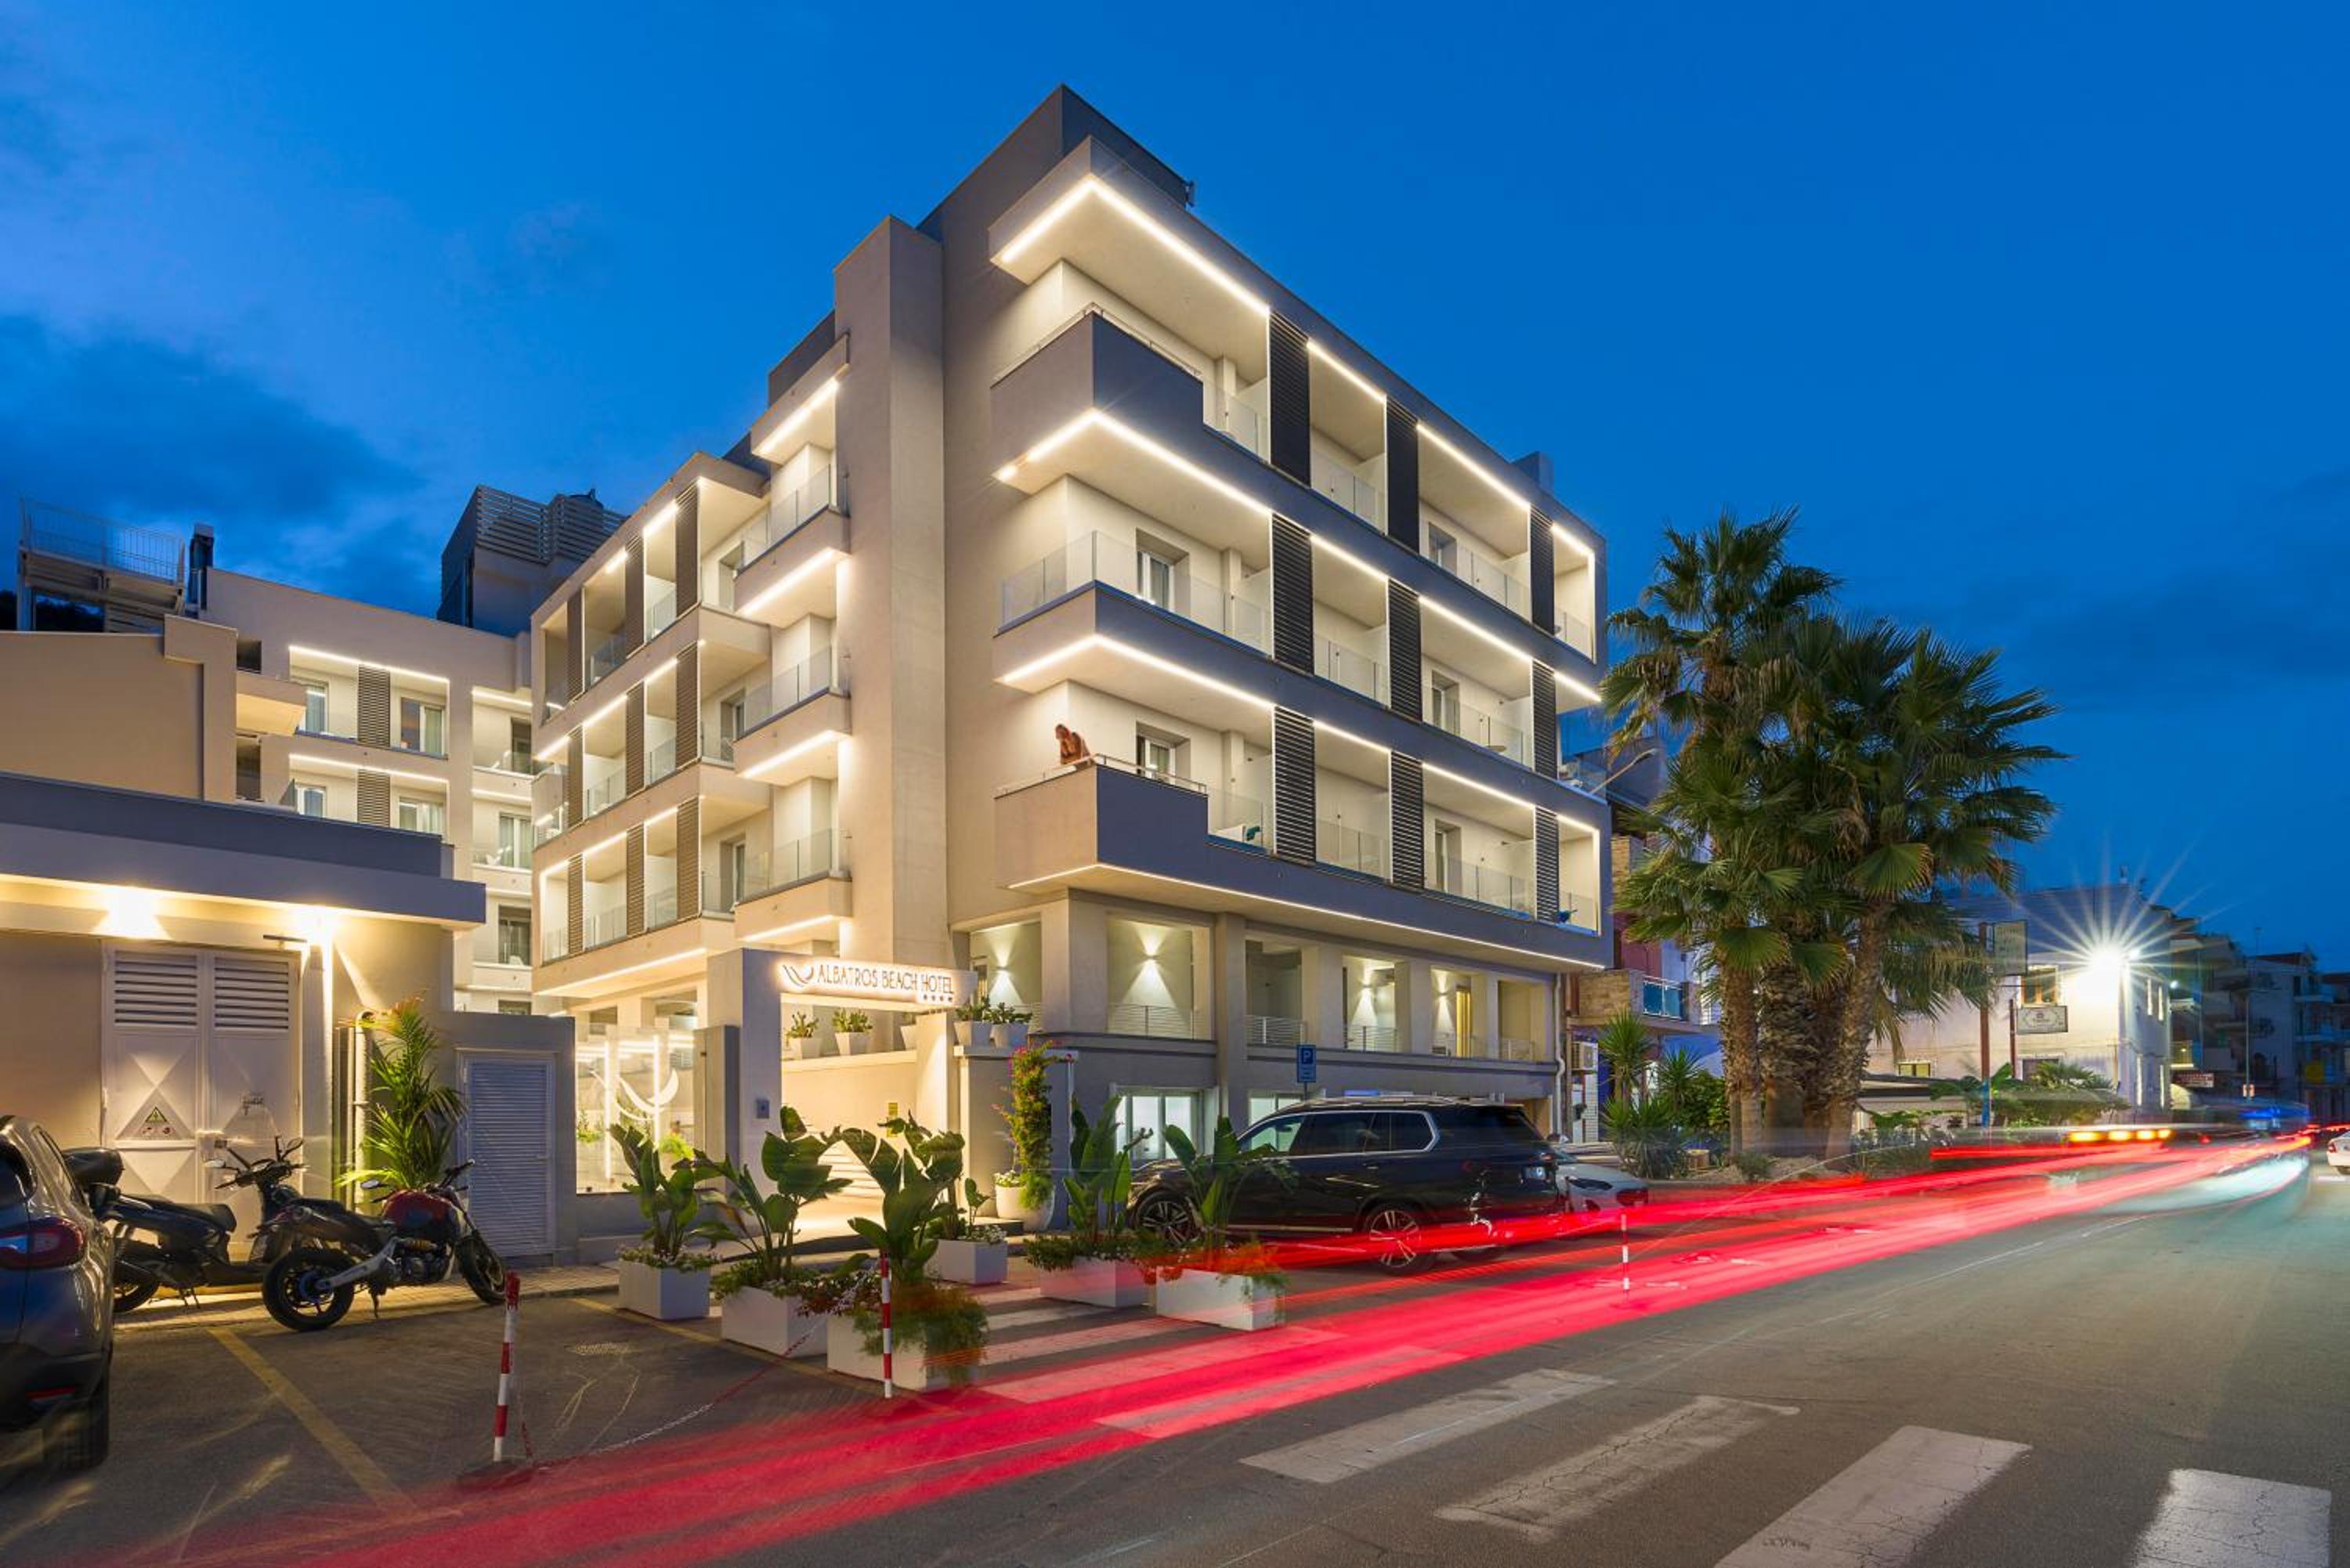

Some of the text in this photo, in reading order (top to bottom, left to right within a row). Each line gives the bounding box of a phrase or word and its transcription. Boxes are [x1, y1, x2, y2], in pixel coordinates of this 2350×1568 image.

[817, 964, 954, 995] ALBATROS BEACH HOTEL
[1303, 1050, 1311, 1063] P
